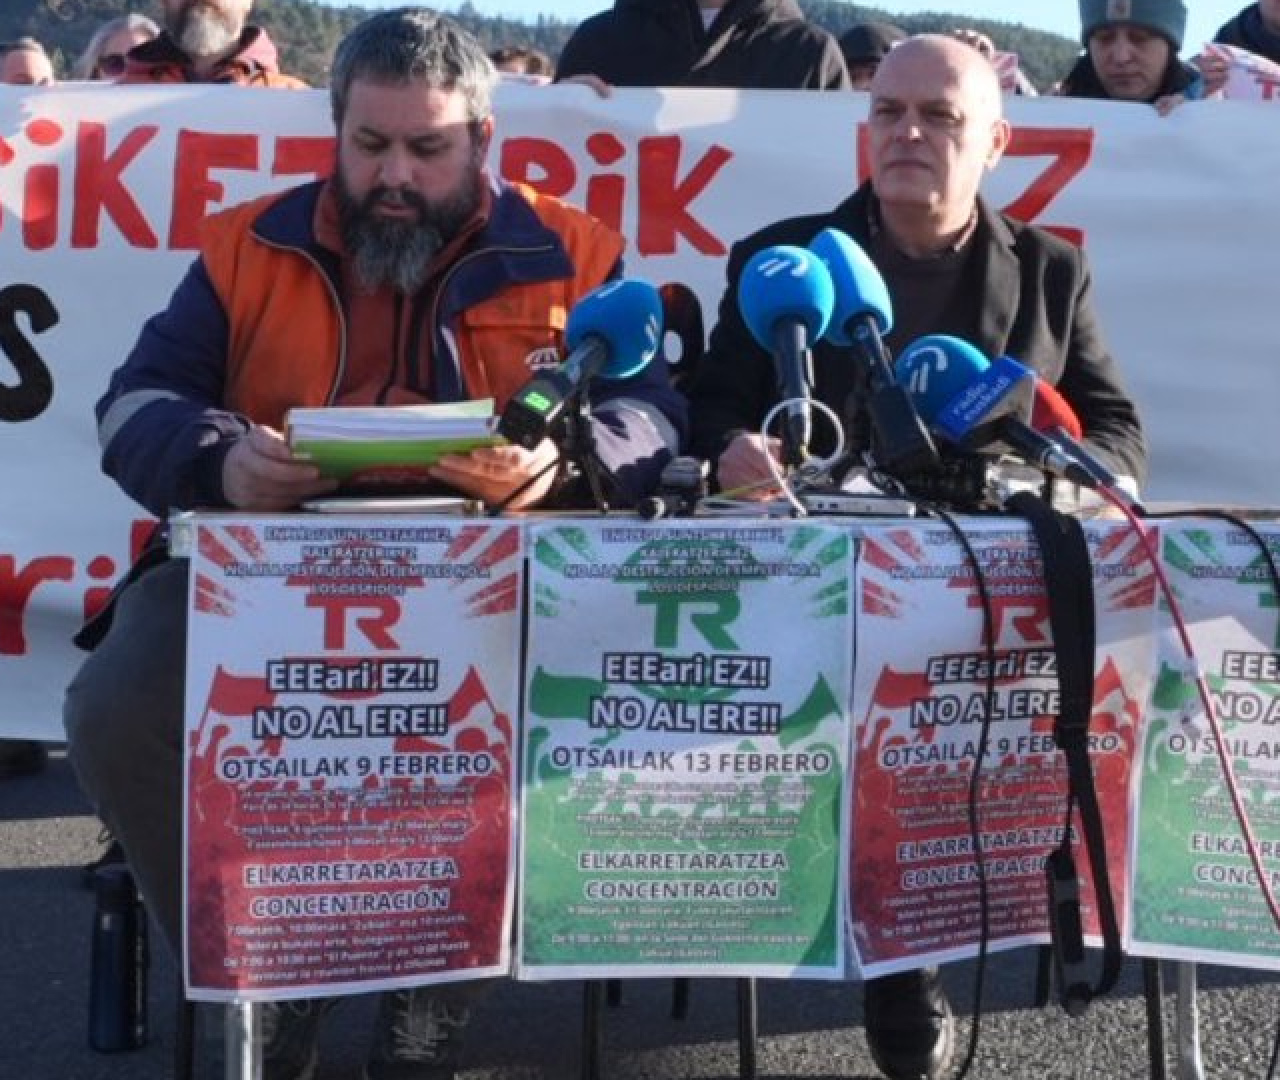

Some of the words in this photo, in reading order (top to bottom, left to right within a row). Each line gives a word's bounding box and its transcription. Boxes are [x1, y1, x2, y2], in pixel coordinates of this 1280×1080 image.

[856, 123, 1095, 246] Z
[306, 595, 402, 650] TR
[636, 592, 740, 650] TR
[267, 660, 373, 693] EEEari
[378, 660, 439, 691] EZ!!
[603, 652, 705, 684] EEEari
[710, 655, 770, 687] EZ!!
[1022, 651, 1058, 677] EZ
[253, 706, 314, 739] NO
[315, 706, 362, 738] AL
[366, 705, 449, 735] ERE!!
[589, 697, 646, 729] NO
[647, 699, 696, 731] AL
[700, 703, 780, 734] ERE!!
[910, 696, 961, 728] NO
[1008, 689, 1062, 719] ERE
[1213, 692, 1262, 722] NO
[552, 747, 676, 773] OTSAILAK
[684, 751, 711, 773] 13
[718, 752, 831, 774] FEBRERO
[997, 737, 1011, 755] 9
[1017, 734, 1118, 754] FEBRO
[223, 756, 350, 780] OTSAILAK
[357, 756, 372, 777] 9
[379, 753, 492, 776] FEBRERO
[897, 824, 1080, 862] ELKARRTARATZEA
[244, 857, 458, 887] ELKARRETARATZEA
[579, 851, 788, 871] ELKARRETARATZEA
[251, 885, 449, 917] CONCENTRACIÓN
[585, 874, 779, 900] CONCENTRACIÓN
